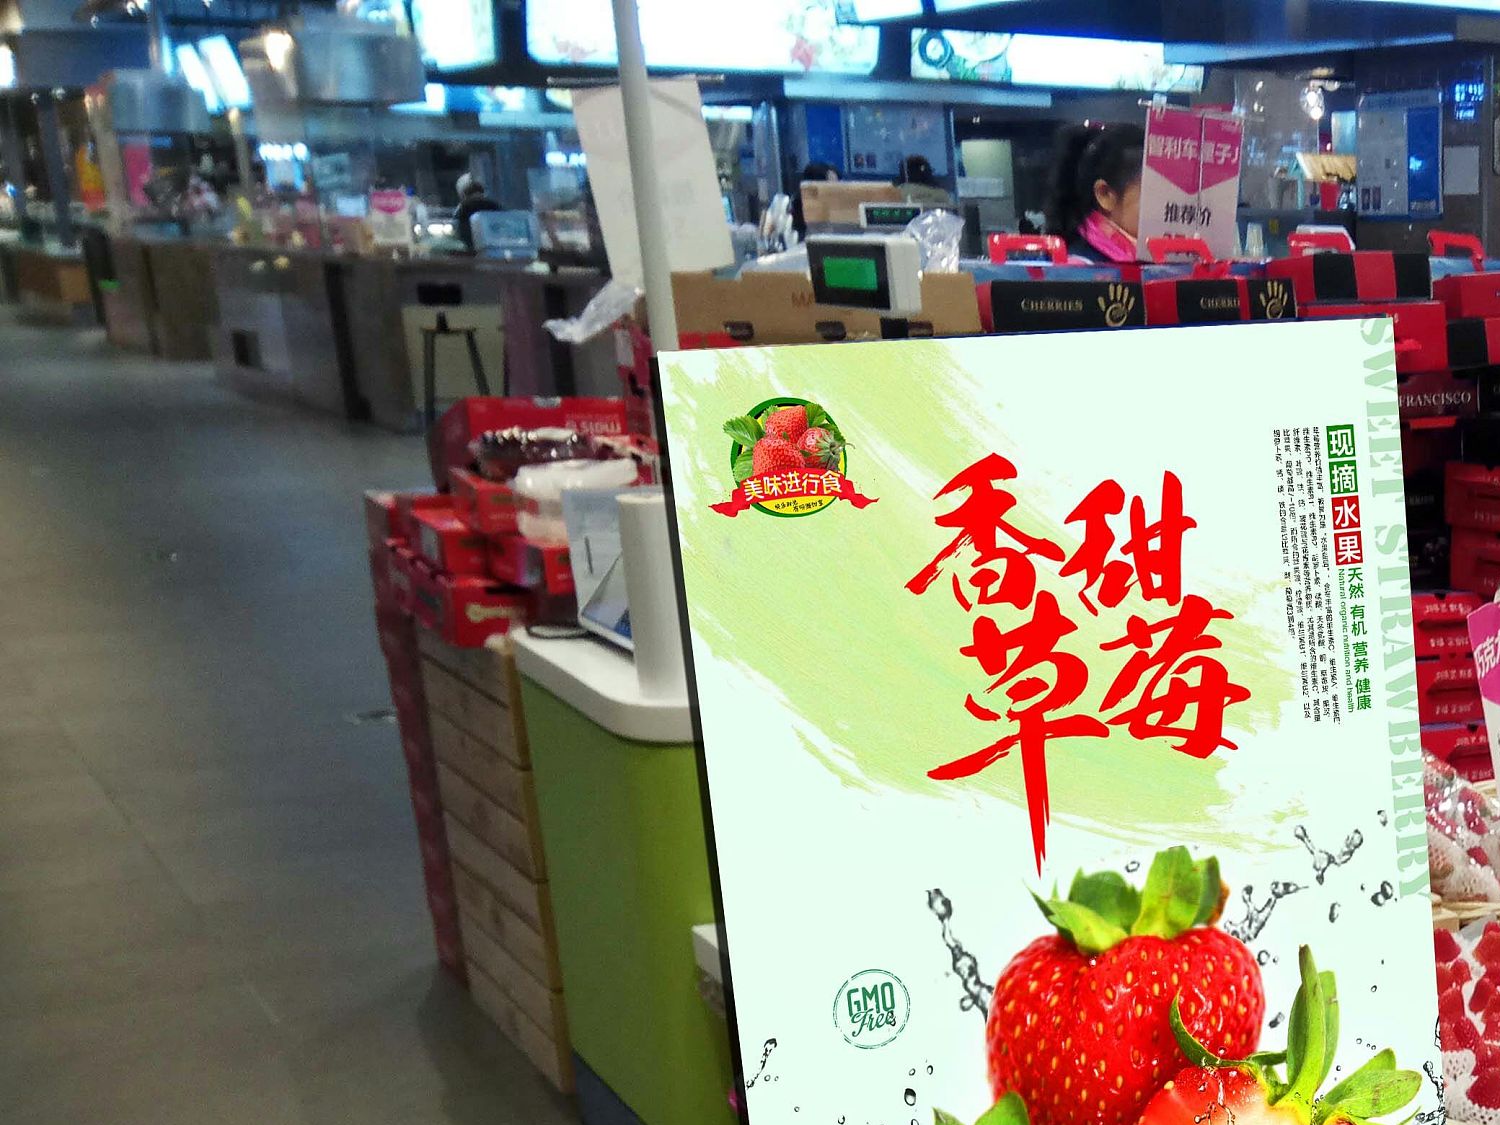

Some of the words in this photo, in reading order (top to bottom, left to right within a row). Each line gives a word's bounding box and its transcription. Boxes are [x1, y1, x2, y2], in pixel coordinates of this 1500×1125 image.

[1020, 298, 1083, 312] CHERRIES
[1399, 391, 1471, 408] FRANCISCO
[742, 469, 843, 501] 美味进行食
[1327, 426, 1363, 564] 现摘水果
[904, 452, 1197, 616] 香甜
[1338, 568, 1347, 599] Natural
[1347, 567, 1365, 600] 天然
[1350, 604, 1368, 637] 有机
[1352, 641, 1370, 674] 营养
[1355, 678, 1372, 711] 健康
[927, 590, 1251, 879] 草莓
[846, 981, 896, 1017] GMO
[850, 1008, 897, 1038] Free
